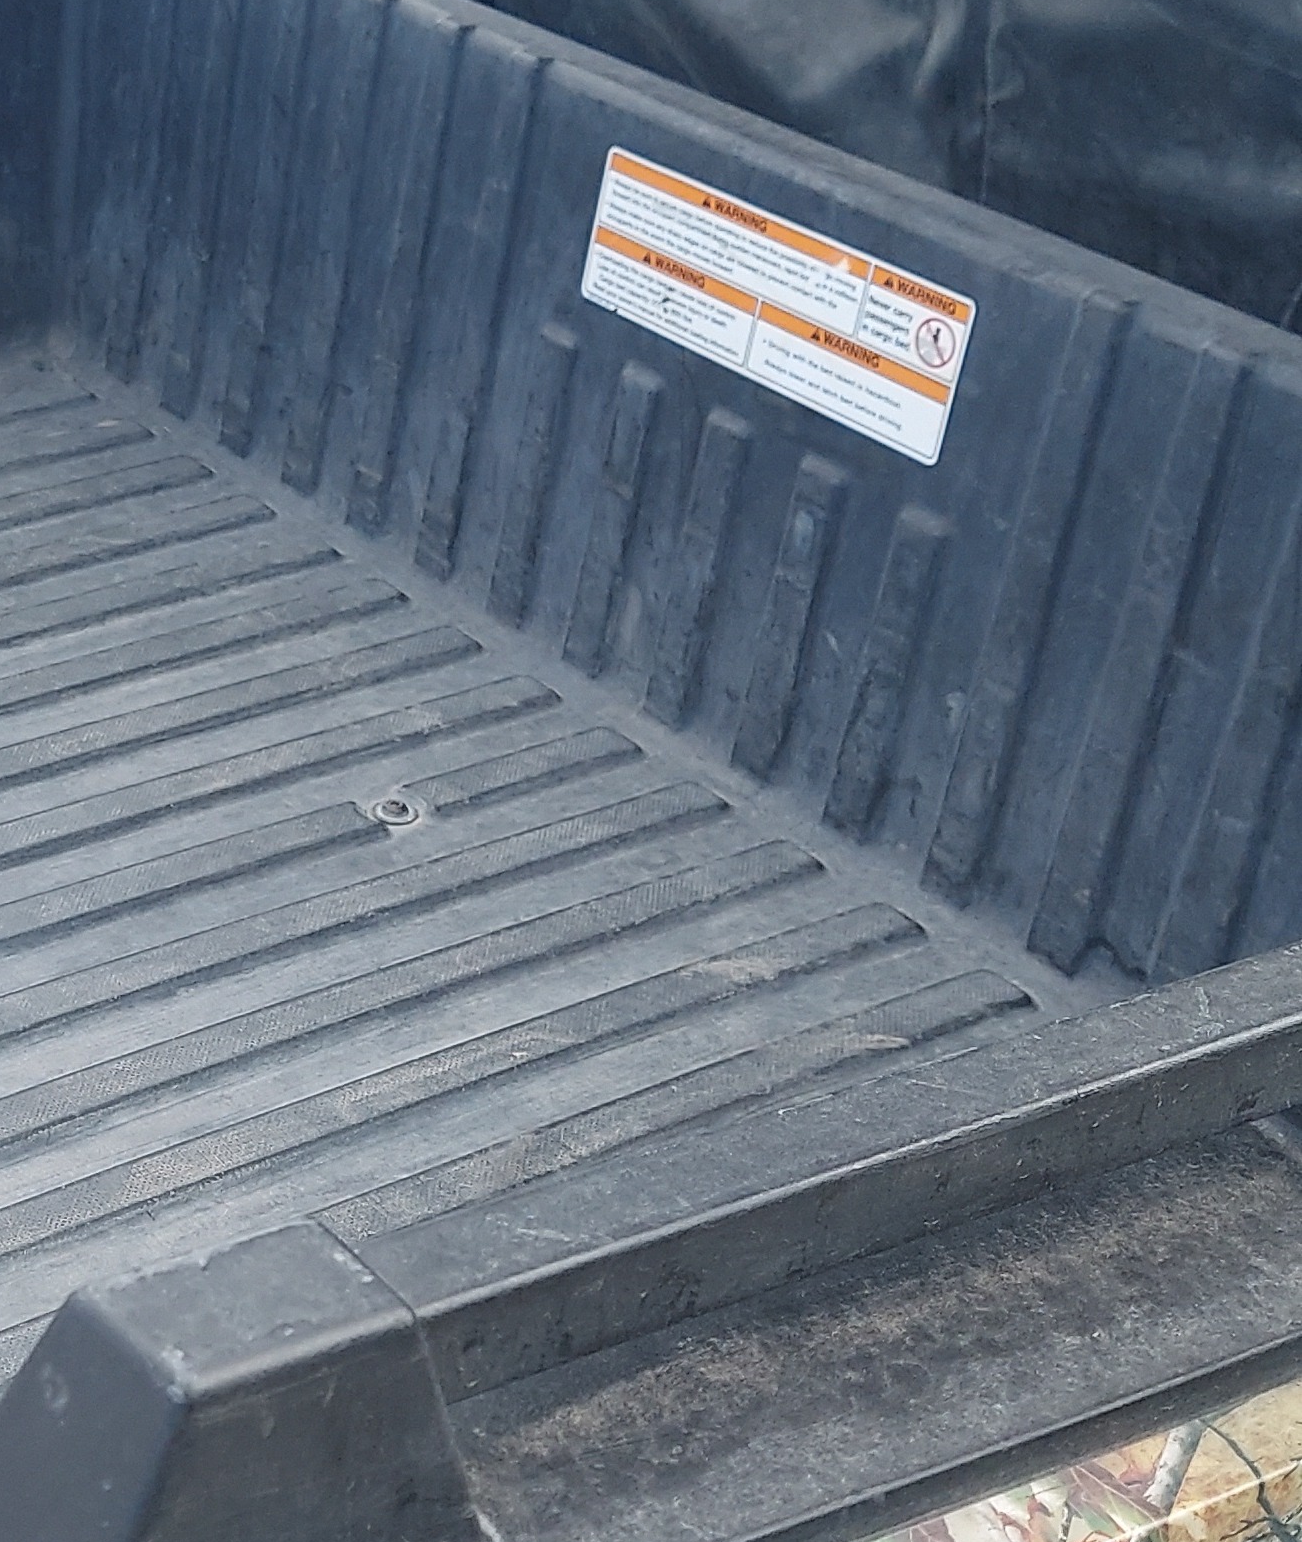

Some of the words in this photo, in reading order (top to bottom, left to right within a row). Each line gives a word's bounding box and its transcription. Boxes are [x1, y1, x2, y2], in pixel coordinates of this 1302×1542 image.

[714, 198, 767, 232] WARNING
[655, 256, 705, 289] WARNING
[898, 279, 957, 315] WARNING
[823, 331, 880, 368] WARNING
